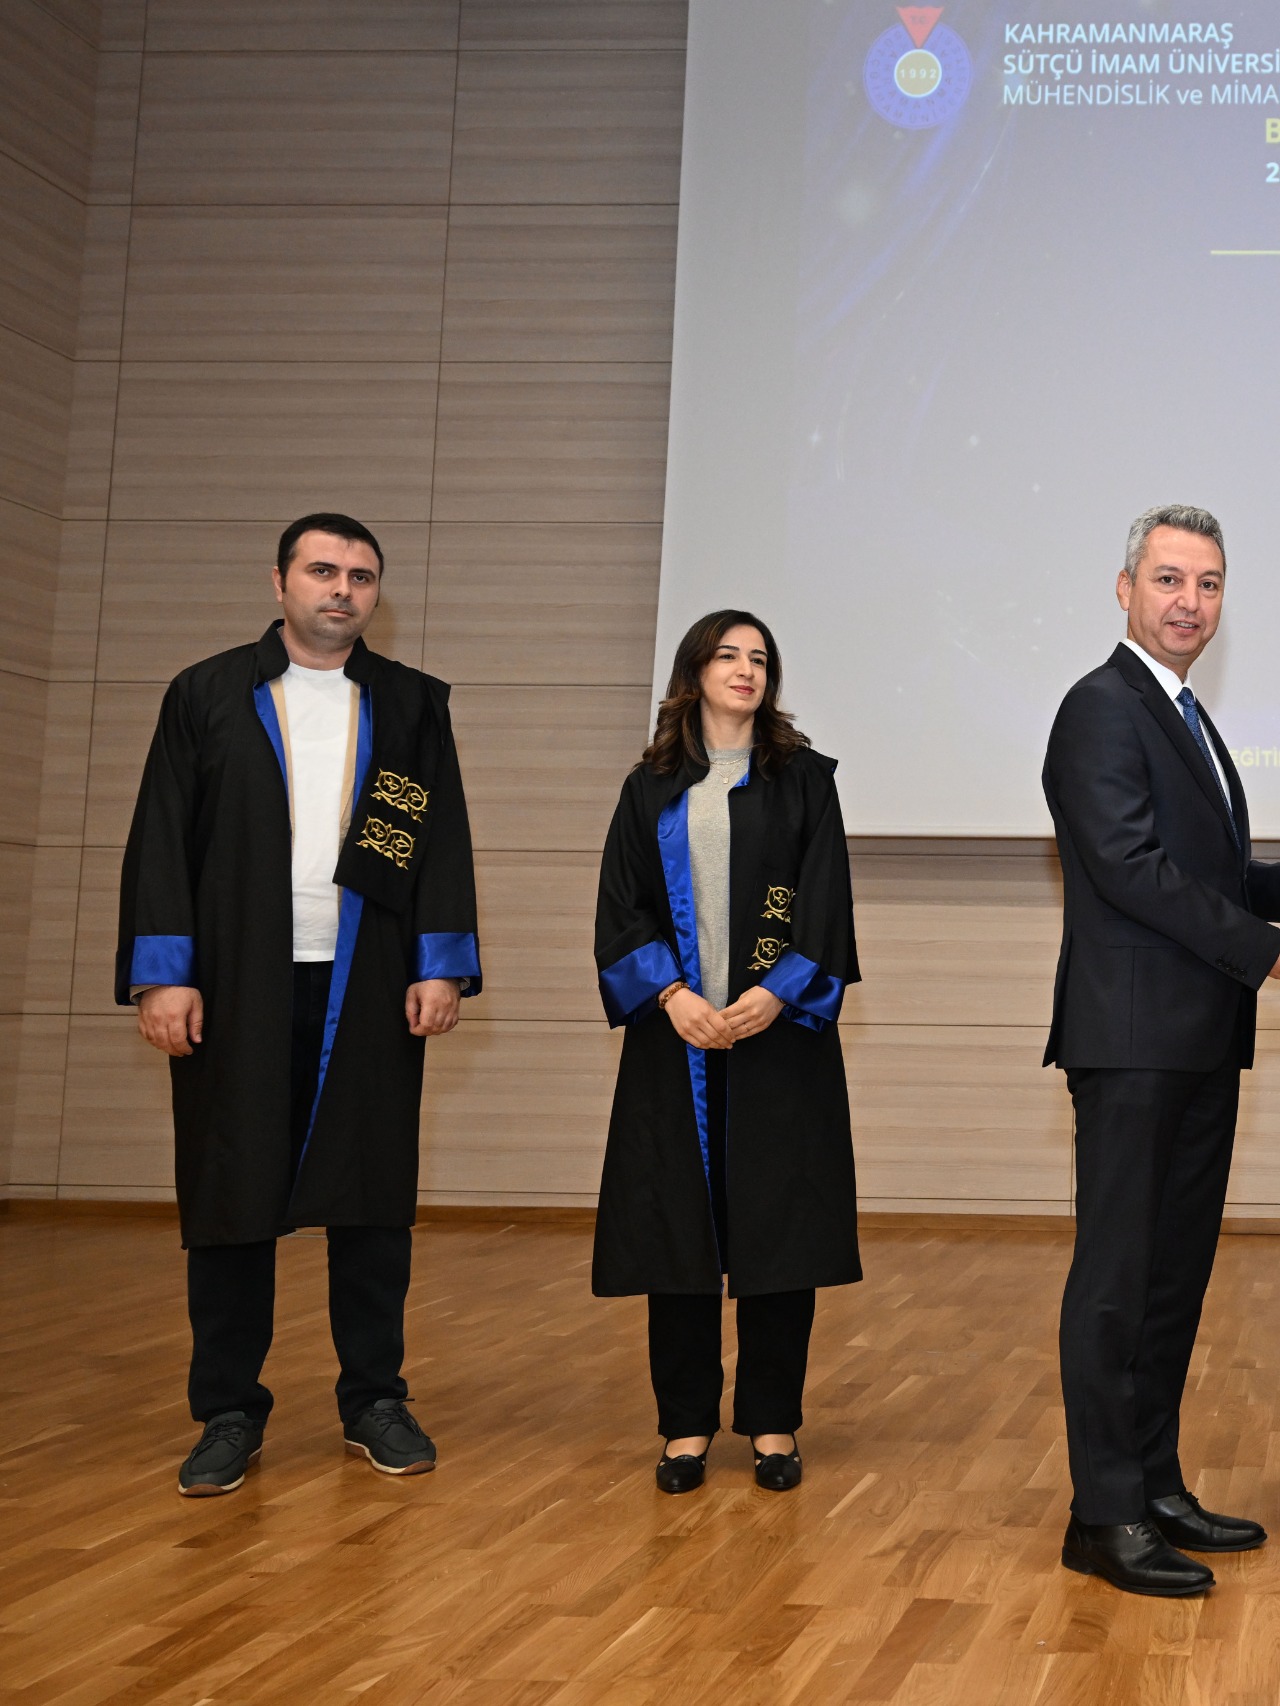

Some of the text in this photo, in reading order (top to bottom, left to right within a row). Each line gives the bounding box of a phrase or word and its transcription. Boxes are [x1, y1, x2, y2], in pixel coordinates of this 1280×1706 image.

[1004, 22, 1234, 48] KAHRAMANMARAŞ
[899, 68, 938, 80] 1992
[1003, 50, 1083, 80] SÜTÇÜ
[1091, 49, 1160, 74] İMAM
[1003, 77, 1170, 105] MÜHENDİSLİK
[1176, 90, 1203, 105] ve
